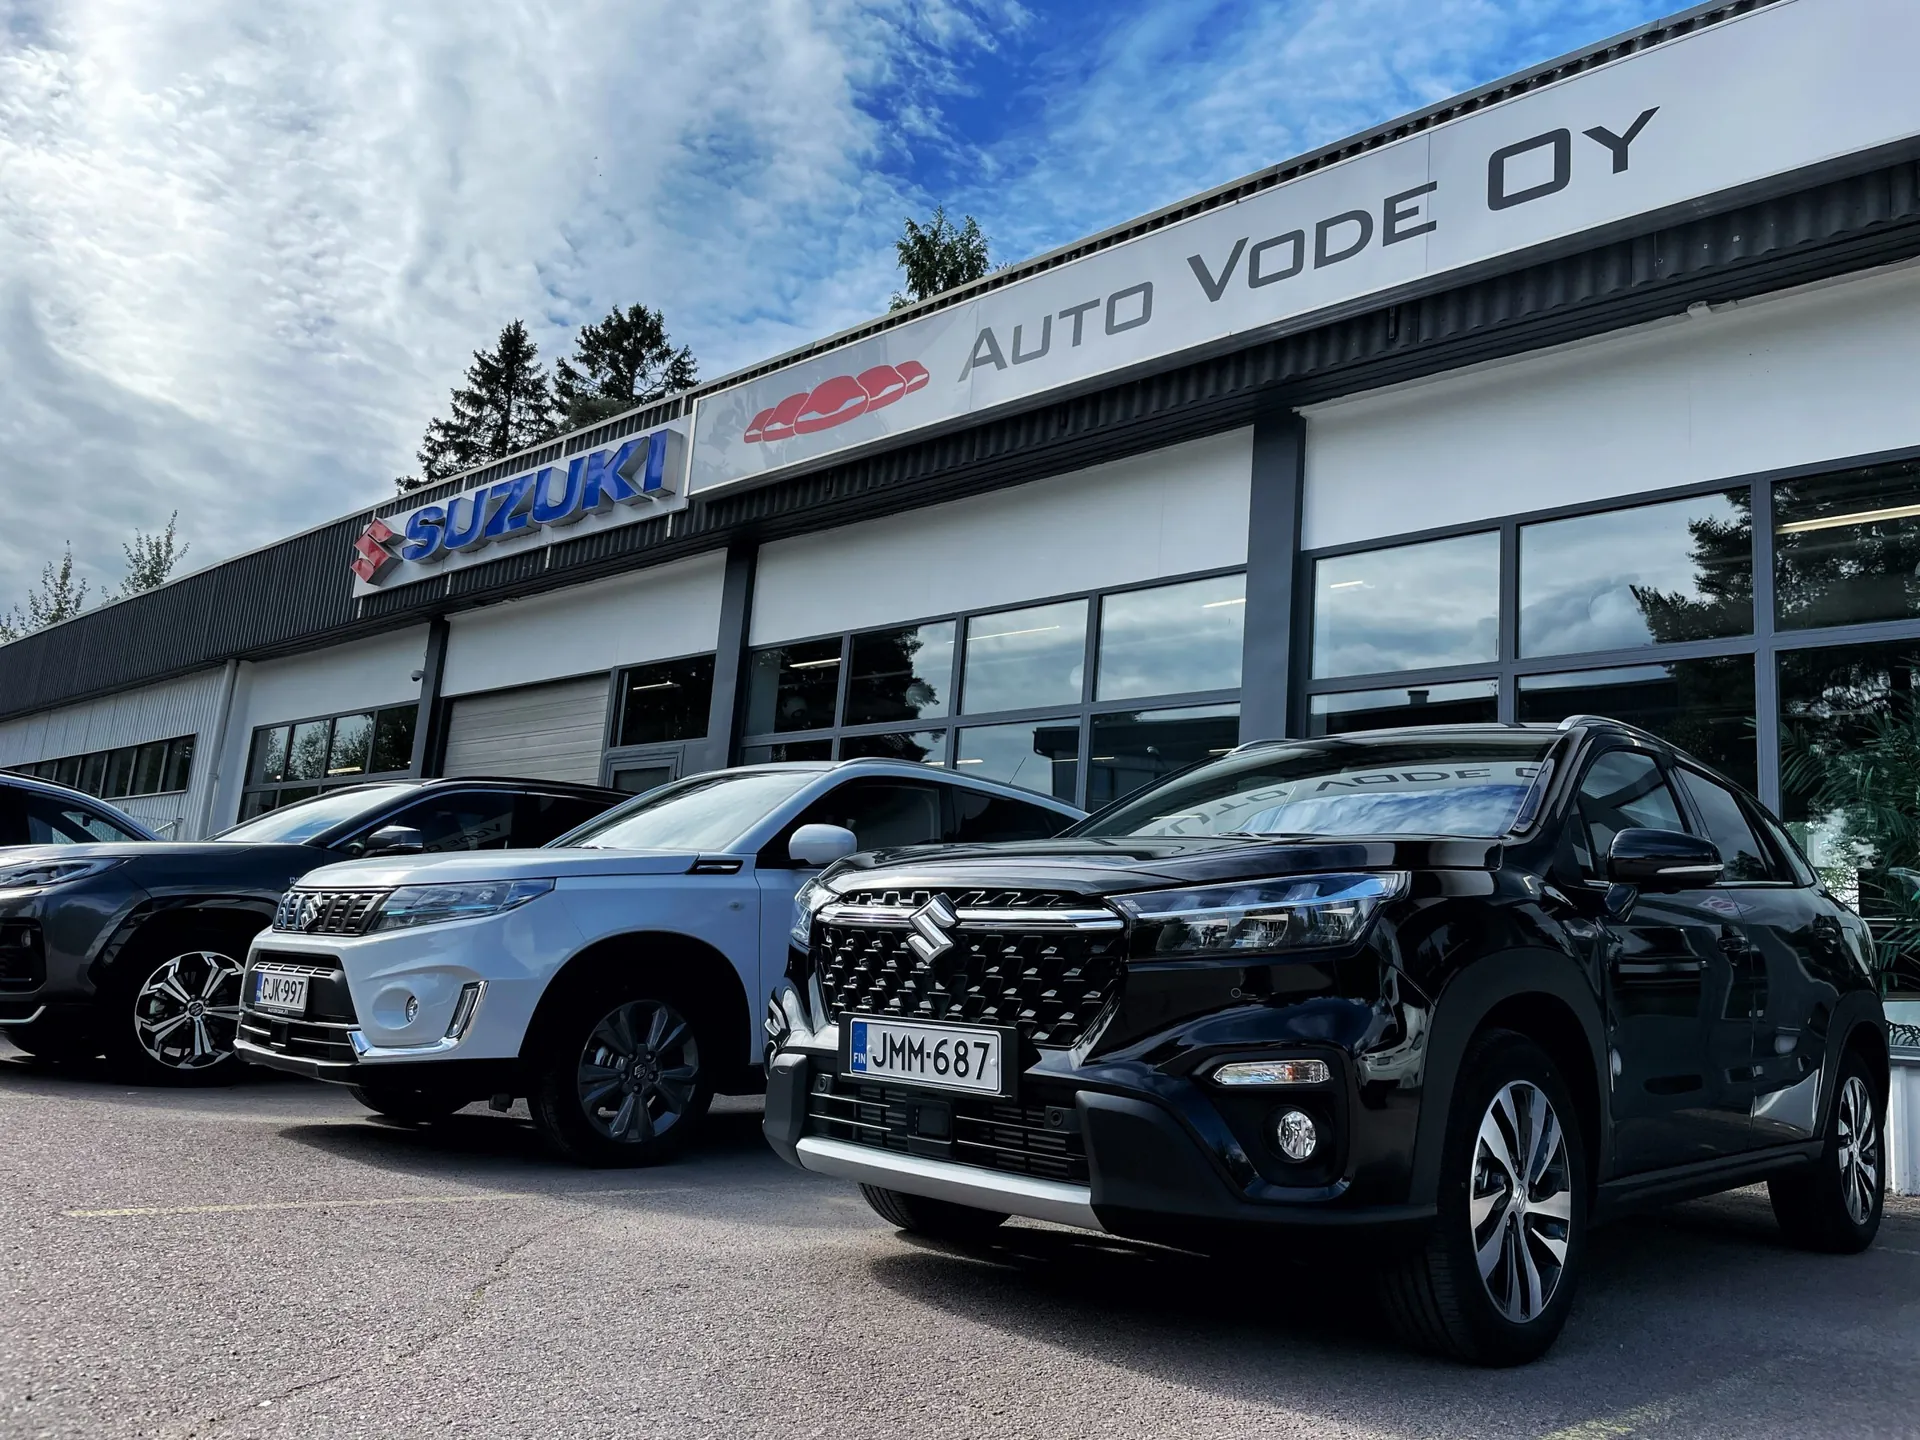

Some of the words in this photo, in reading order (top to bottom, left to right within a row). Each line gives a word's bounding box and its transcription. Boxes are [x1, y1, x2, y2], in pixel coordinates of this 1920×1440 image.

[958, 280, 1154, 382] AUTO
[1187, 180, 1438, 303] VODE
[1487, 106, 1661, 211] OY
[401, 428, 674, 565] SUZUKI
[262, 978, 305, 1004] CJK-997
[853, 1053, 866, 1064] FIN
[872, 1031, 990, 1080] JMM-687
